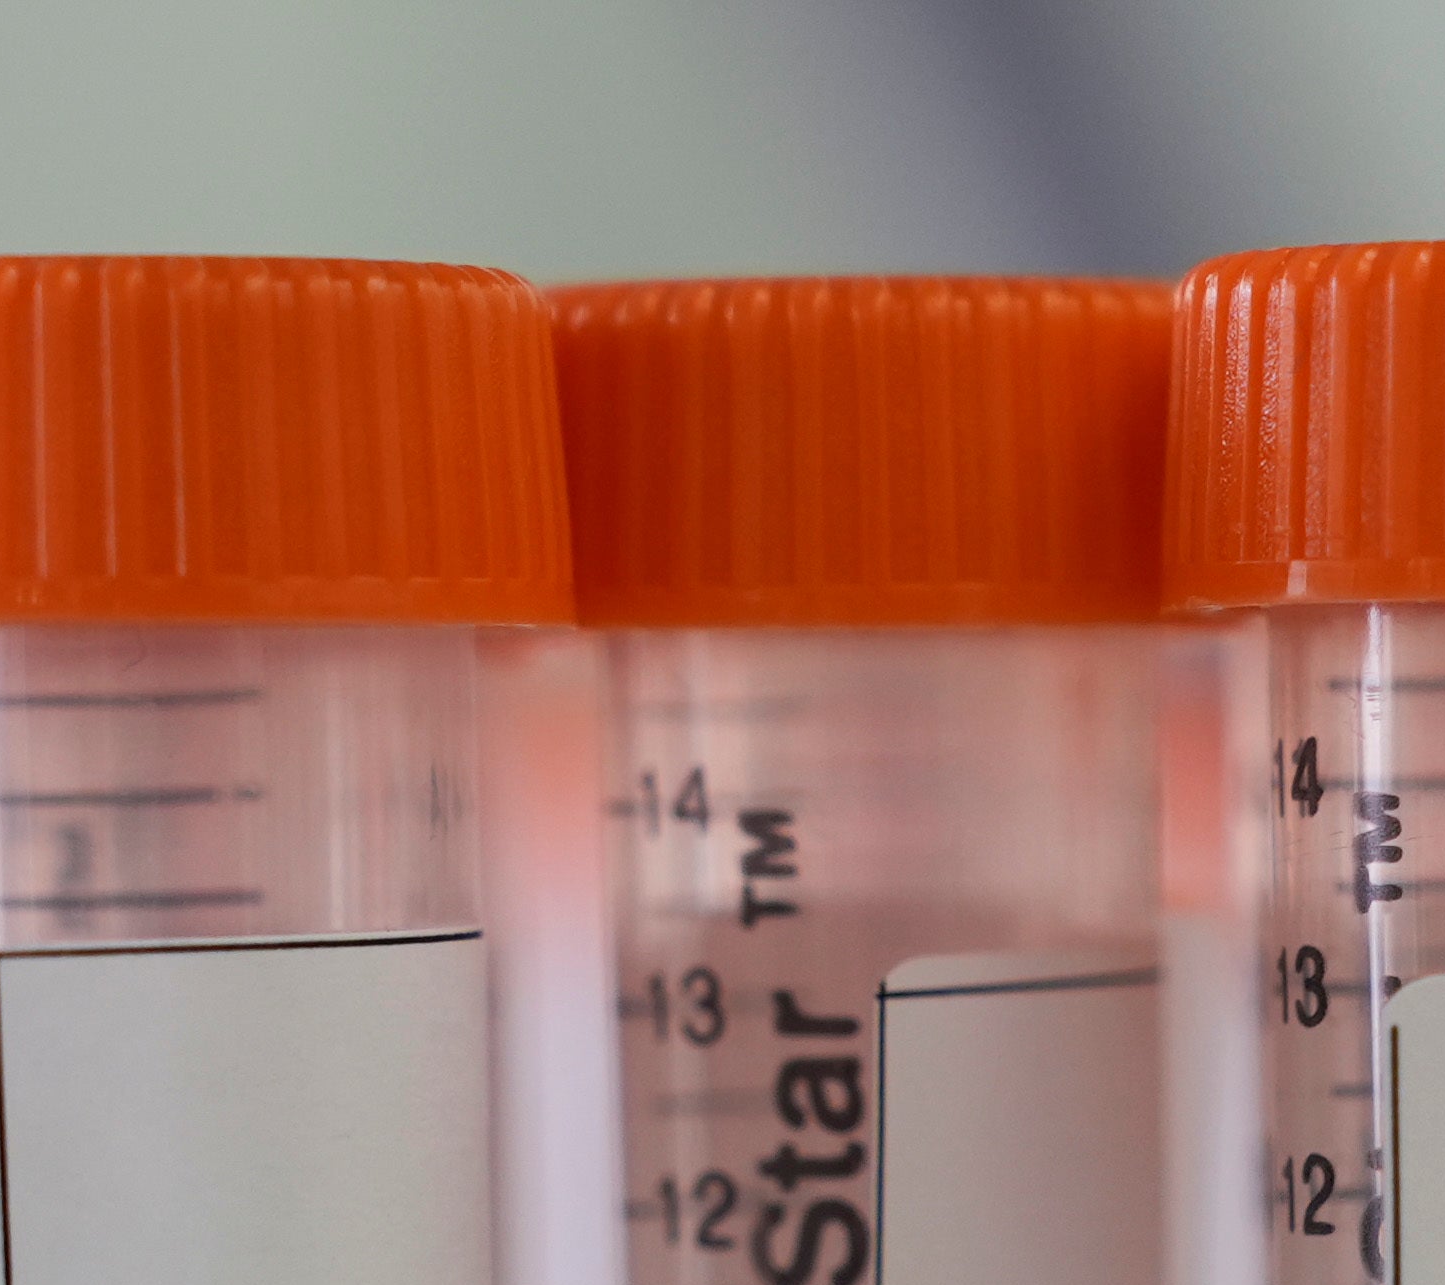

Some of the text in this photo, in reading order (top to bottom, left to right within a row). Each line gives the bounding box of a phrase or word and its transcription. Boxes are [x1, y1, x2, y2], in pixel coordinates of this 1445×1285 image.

[638, 767, 709, 836] 14
[1274, 737, 1323, 816] 14
[646, 967, 725, 1045] 13
[1279, 945, 1328, 1028] 13
[659, 1172, 735, 1249] 12
[1283, 1154, 1336, 1237] 12
